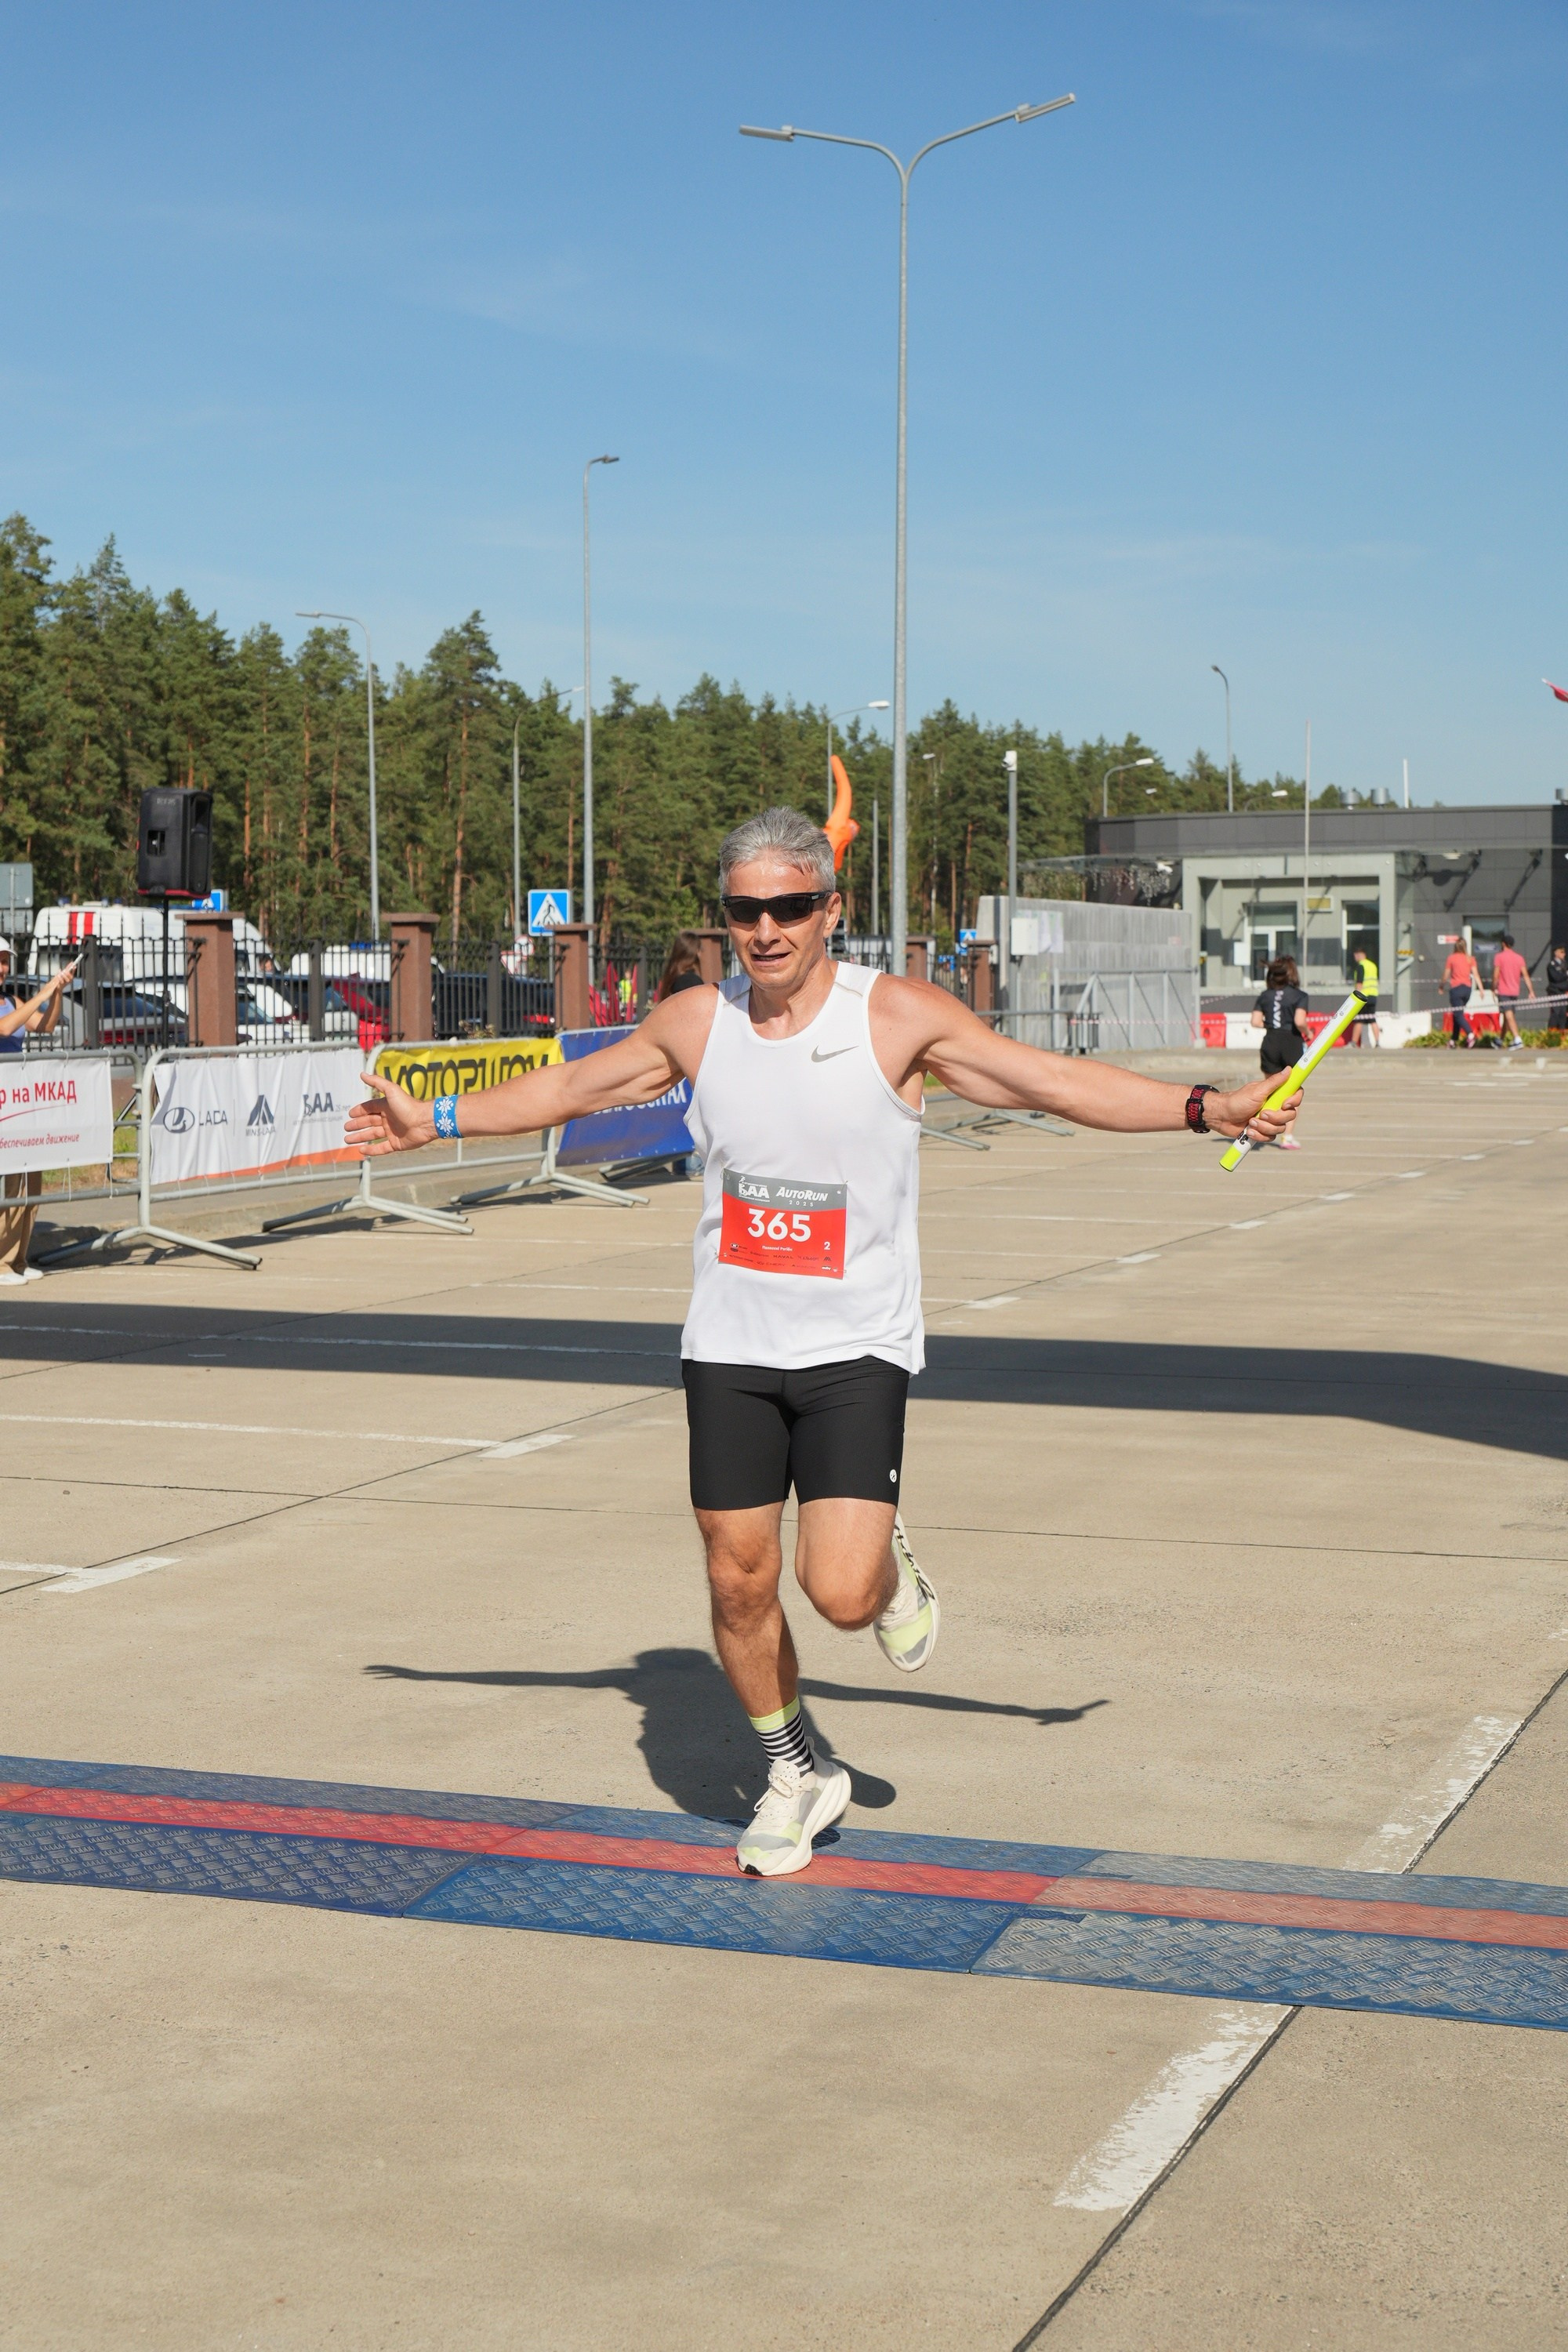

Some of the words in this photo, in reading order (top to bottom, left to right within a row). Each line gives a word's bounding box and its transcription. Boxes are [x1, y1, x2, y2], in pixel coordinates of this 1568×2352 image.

[13, 1087, 30, 1104] на
[34, 1080, 77, 1104] МКАД
[198, 1110, 228, 1126] LADA
[45, 1134, 79, 1145] движение
[747, 1207, 811, 1243] 365
[823, 1241, 831, 1250] 2
